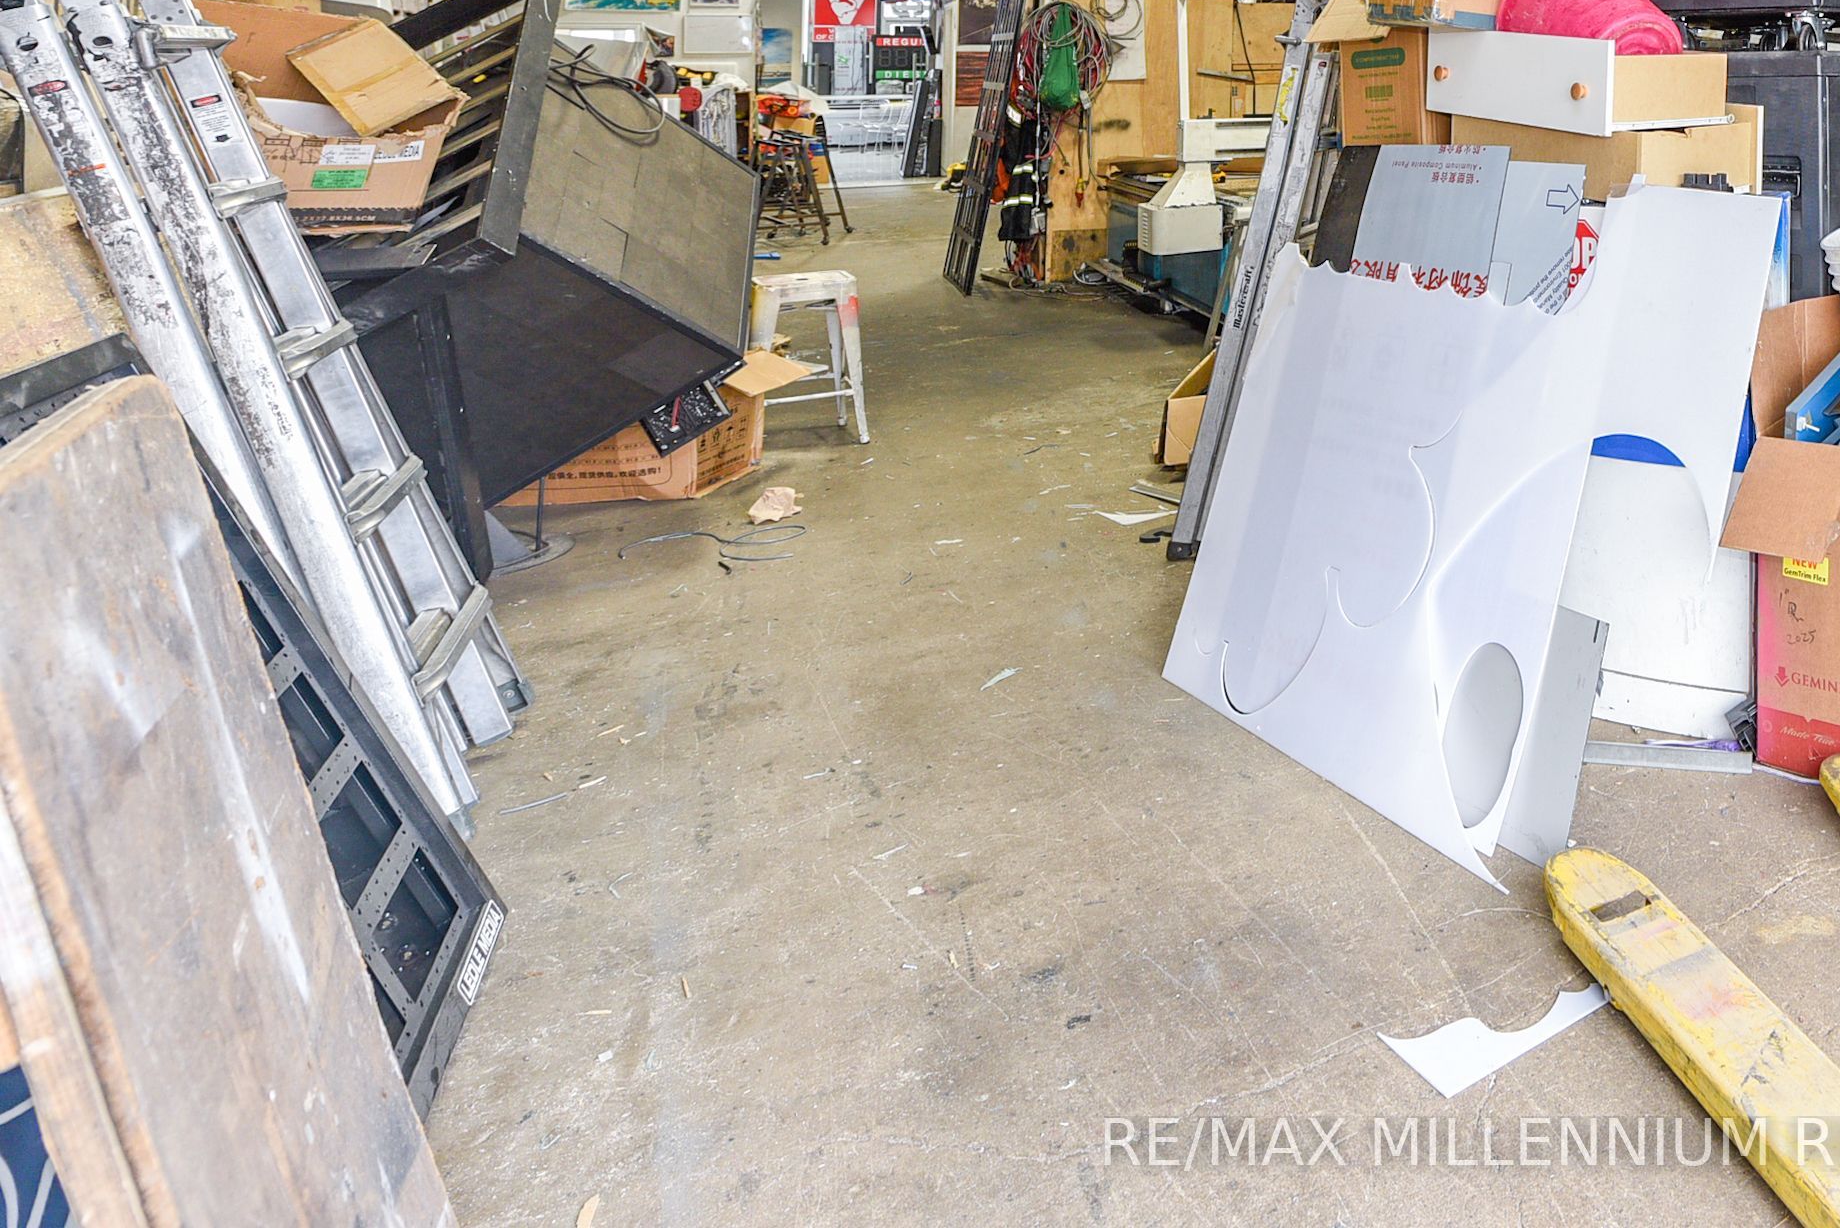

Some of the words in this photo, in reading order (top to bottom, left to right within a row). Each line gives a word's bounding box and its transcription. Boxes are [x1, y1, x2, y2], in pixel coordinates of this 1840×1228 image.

[883, 37, 923, 47] REGU
[1445, 163, 1478, 172] Aluminum
[1792, 557, 1819, 570] NEW
[1784, 567, 1812, 580] GemTrim
[1812, 573, 1827, 583] Flex
[460, 947, 486, 1000] LEDLE
[477, 908, 501, 956] MEDIA
